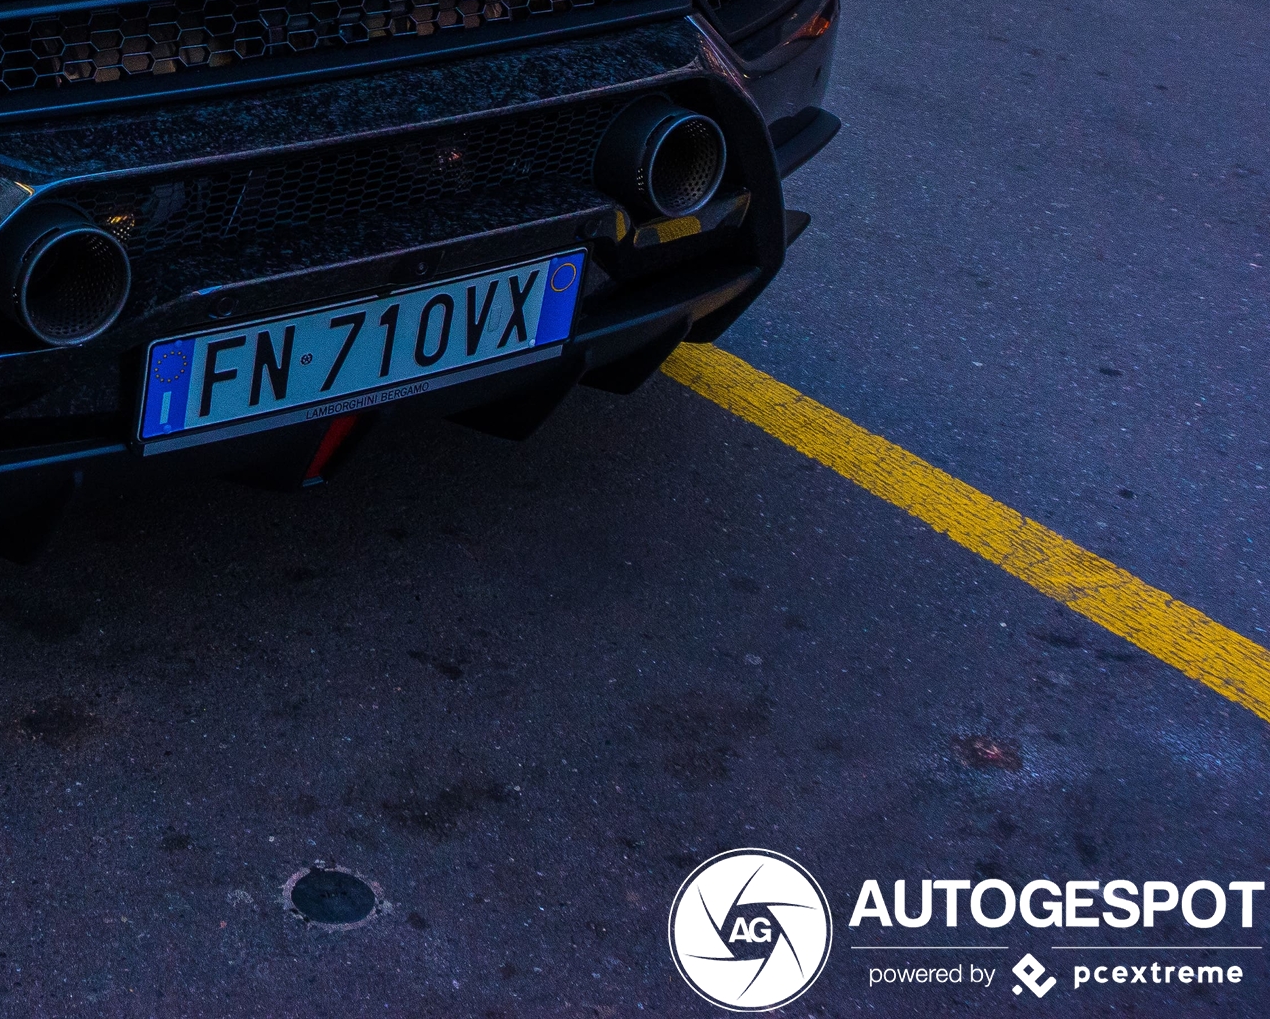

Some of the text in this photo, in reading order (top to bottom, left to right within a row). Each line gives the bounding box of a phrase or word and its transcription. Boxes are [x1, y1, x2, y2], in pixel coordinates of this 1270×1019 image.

[198, 269, 541, 418] FN 710VX
[306, 381, 430, 420] LAMBORGHINI BERGAMO
